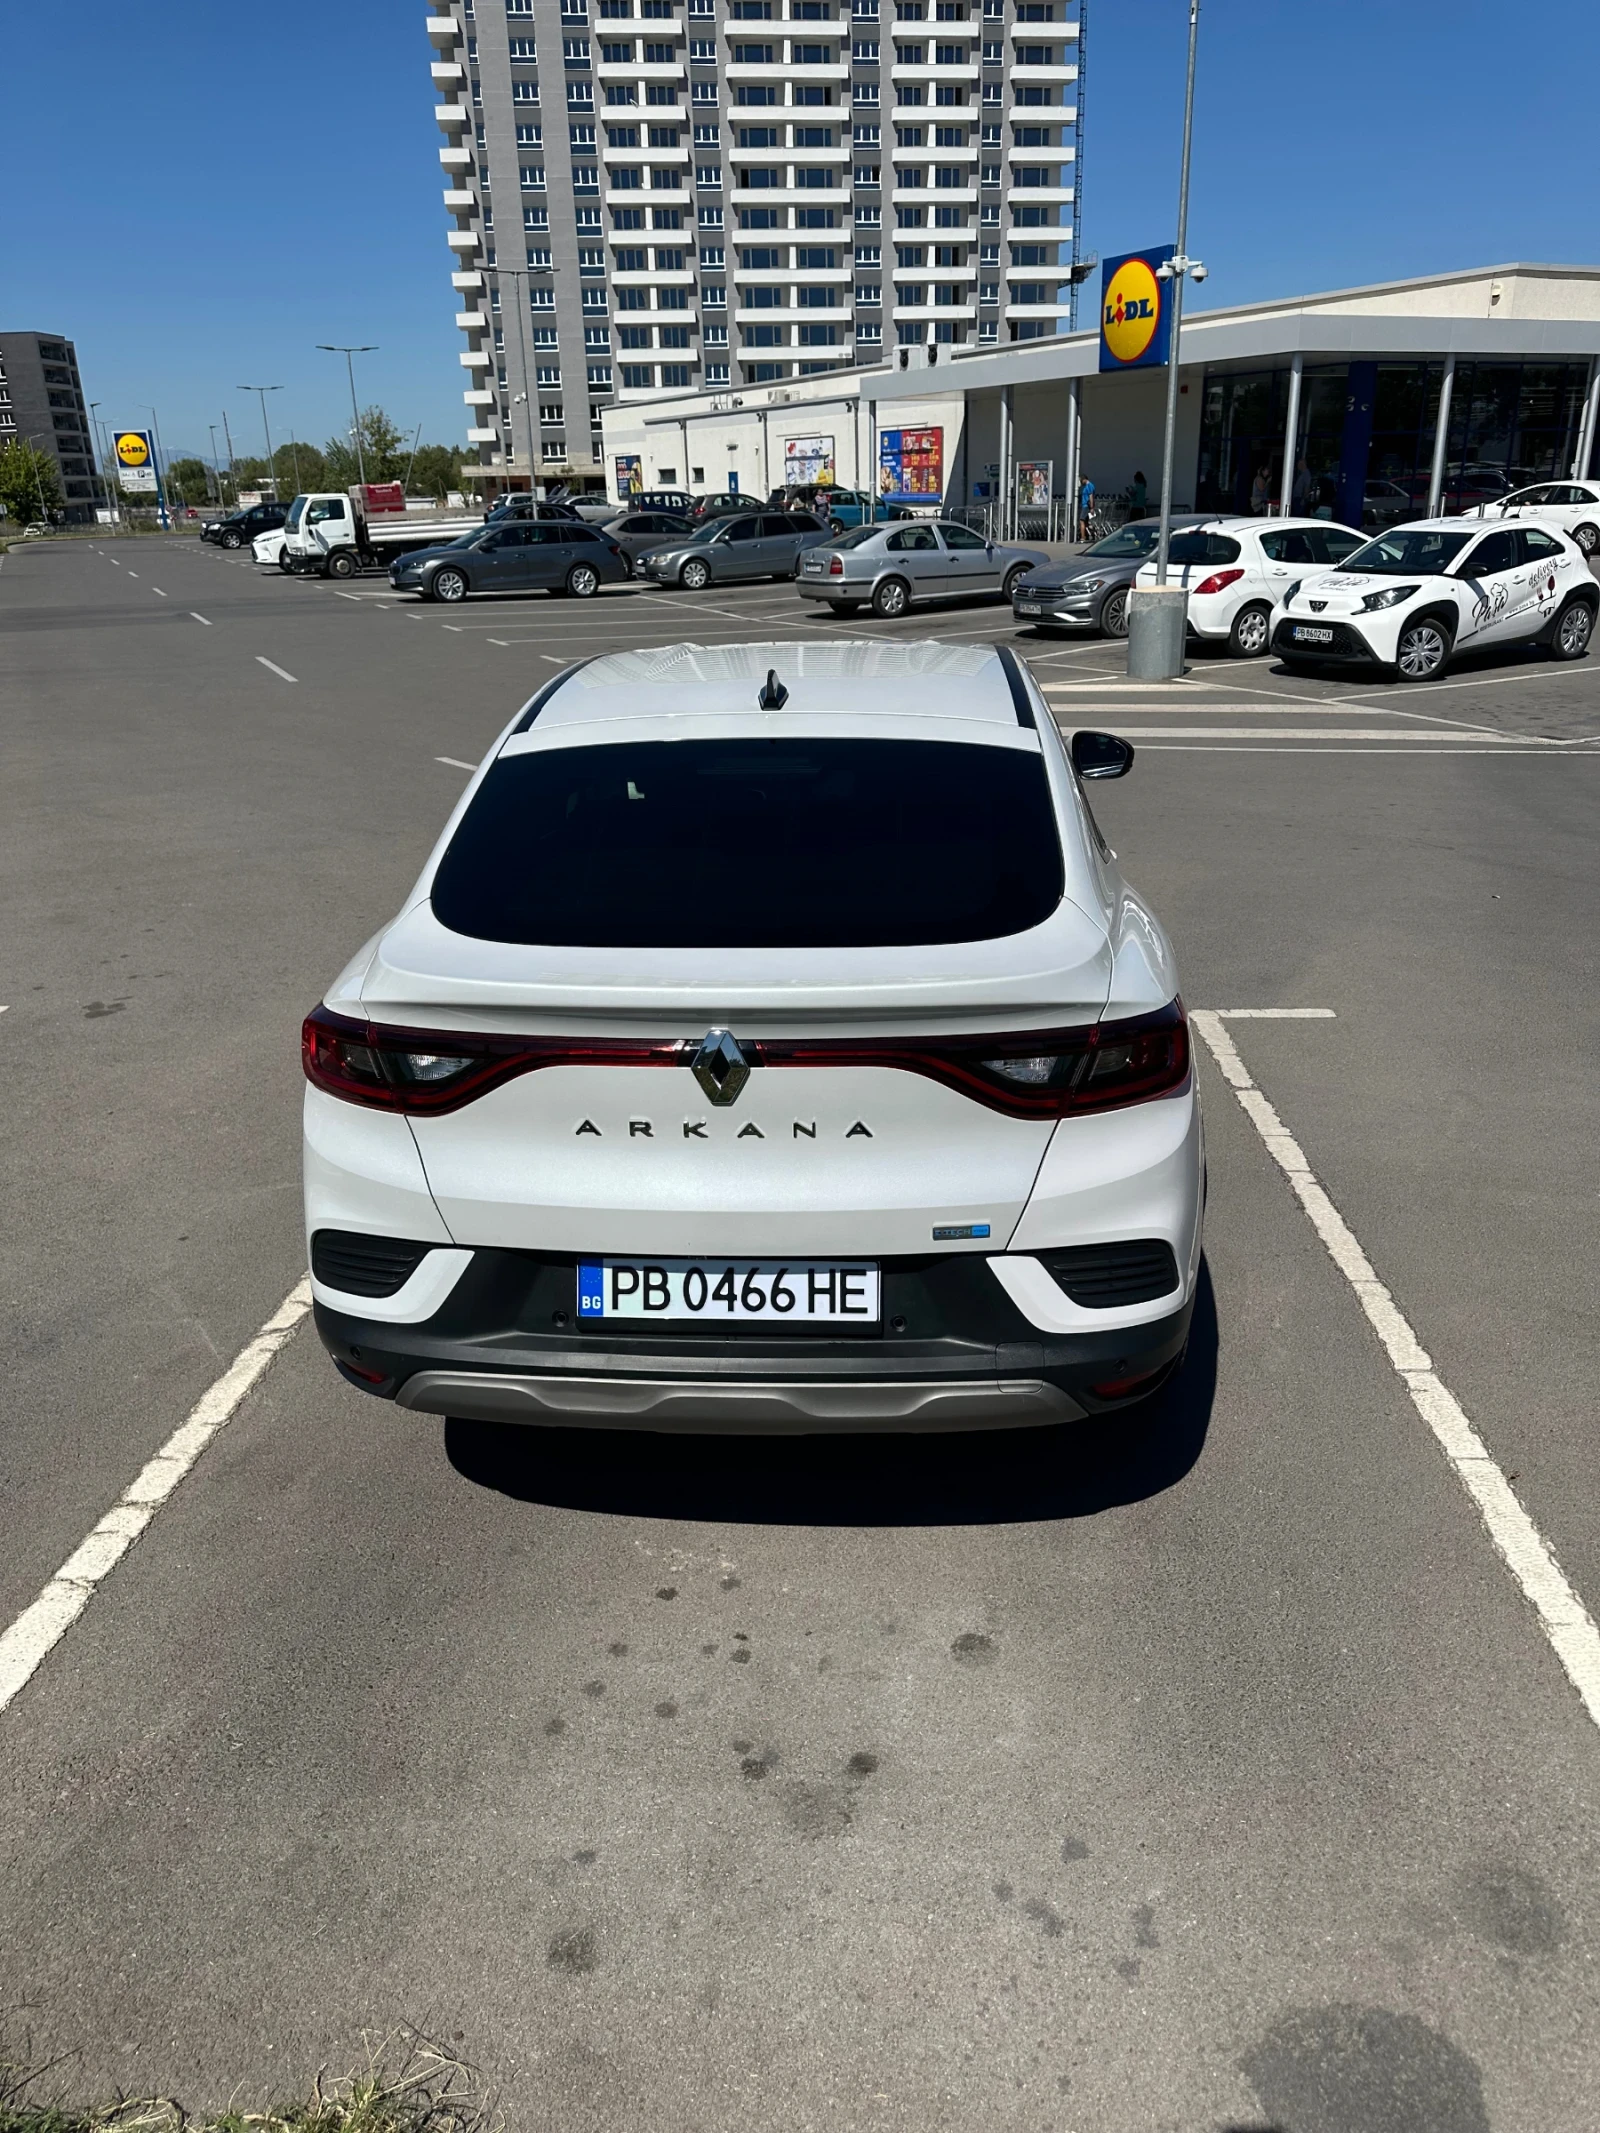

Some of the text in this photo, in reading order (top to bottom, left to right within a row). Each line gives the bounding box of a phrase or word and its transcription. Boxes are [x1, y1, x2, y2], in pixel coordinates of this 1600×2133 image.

[1528, 557, 1559, 586] delivery
[1297, 628, 1306, 637] PB
[1306, 629, 1322, 639] 8602
[1322, 630, 1332, 640] HX
[575, 1117, 874, 1139] ARKANA
[611, 1265, 868, 1314] PB 0466 HE
[581, 1296, 602, 1309] BG
